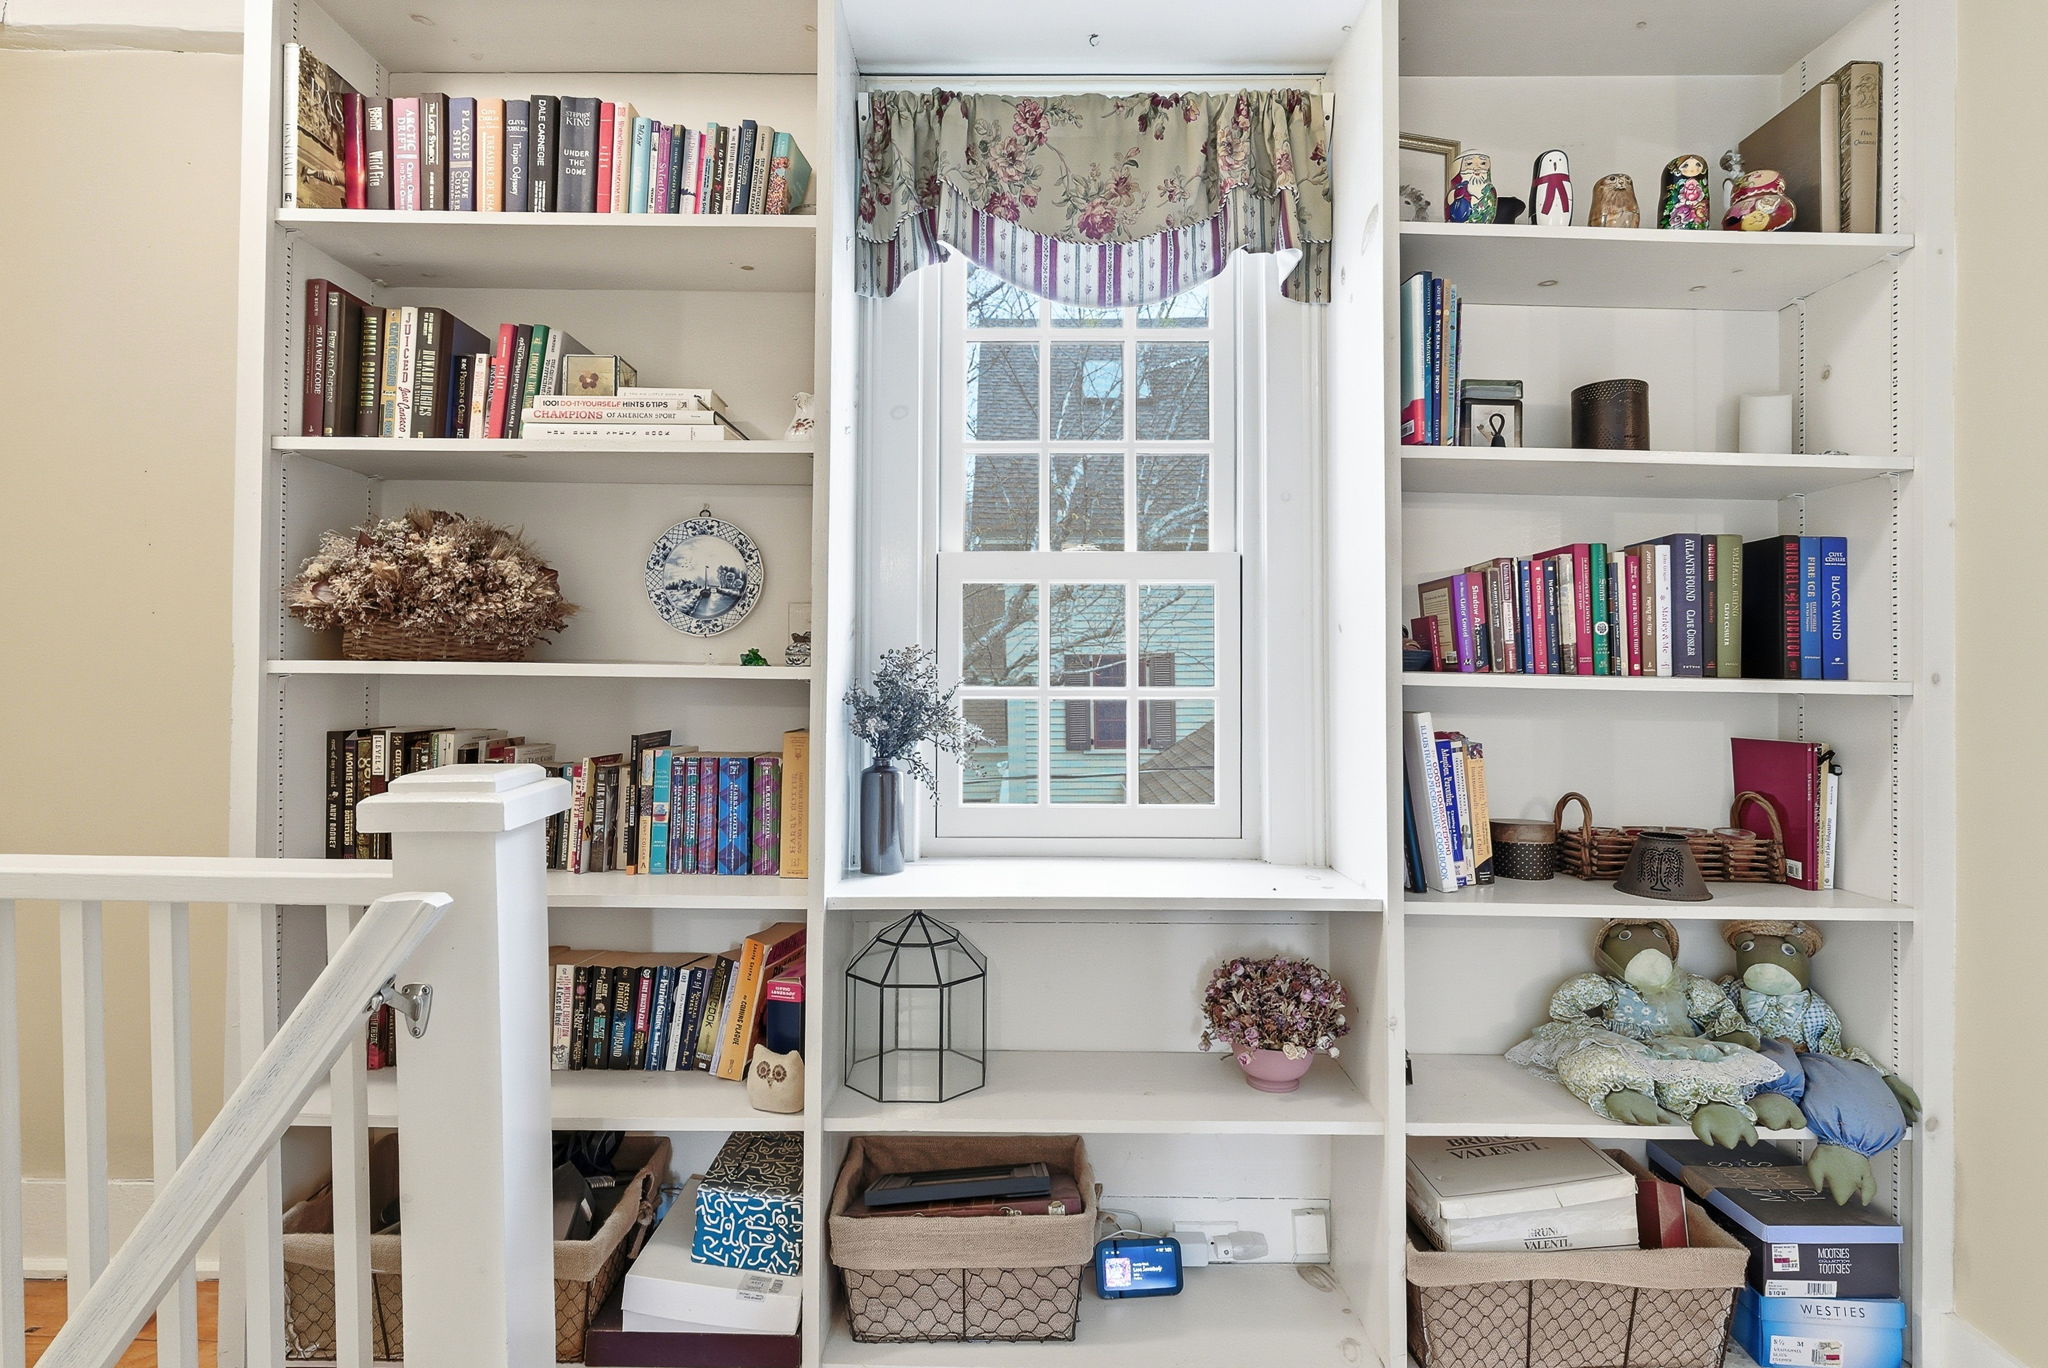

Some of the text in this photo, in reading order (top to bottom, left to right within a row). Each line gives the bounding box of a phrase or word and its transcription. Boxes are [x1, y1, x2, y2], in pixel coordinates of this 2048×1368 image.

[396, 117, 407, 151] DRIFT
[406, 109, 416, 151] ARCTIC
[428, 114, 437, 133] LOST
[462, 110, 470, 159] PLAGUE
[537, 100, 547, 167] DALE CARNEGIE
[565, 116, 591, 127] KING
[427, 135, 437, 165] SYMBOL
[452, 130, 461, 159] SHIP
[486, 136, 496, 176] TREASURE
[563, 149, 590, 158] UNDER
[369, 151, 383, 187] Wild Fire
[511, 142, 521, 196] Trojan Odyssey
[564, 167, 589, 176] DOME
[568, 158, 586, 167] THE
[462, 171, 470, 198] CLIVE
[486, 179, 495, 190] OF
[315, 337, 323, 348] DA
[360, 316, 377, 407] MICHAEL CRICHTON
[420, 350, 436, 382] HOWARD
[327, 369, 336, 403] CHOSEN
[418, 385, 434, 417] HUGHES
[397, 402, 411, 433] Canseco
[533, 408, 603, 420] CHAMPIONS
[606, 411, 616, 419] OF
[655, 411, 676, 419] SPORT
[560, 400, 622, 409] DO-IT-YOURSELF
[622, 400, 645, 408] HINTS
[652, 400, 669, 408] TIPS
[1685, 538, 1696, 602] ATLANTIS FOUND
[1732, 546, 1740, 587] VALHALLA
[1785, 542, 1799, 585] MICHAEL
[1807, 556, 1816, 597] FIRE ICE
[1472, 585, 1481, 616] Shadow
[1831, 575, 1842, 640] BLACK WIND
[1661, 606, 1669, 632] Marley
[1685, 609, 1697, 656] CLIVE CUSSLER
[1662, 642, 1668, 654] Me
[1440, 748, 1454, 807] Adoption Parenting
[1477, 765, 1485, 800] Parenting
[1420, 725, 1449, 881] ILLUSTRATED MICROWAVE COOKBOOK
[1432, 762, 1451, 856] GOOD HOUSEKEEPING
[1475, 838, 1484, 856] Child
[621, 983, 630, 1013] NELSON
[657, 979, 668, 1005] Patriot
[654, 1006, 666, 1030] Games
[705, 1001, 718, 1029] COOK
[732, 1000, 748, 1046] COMING PLAGUE
[1449, 1142, 1542, 1160] VALENTI
[1524, 1238, 1568, 1250] VALENTI
[1817, 1248, 1850, 1259] MOOTSIES
[1818, 1263, 1850, 1274] TOOTSIES
[1800, 1304, 1866, 1319] WESTIES
